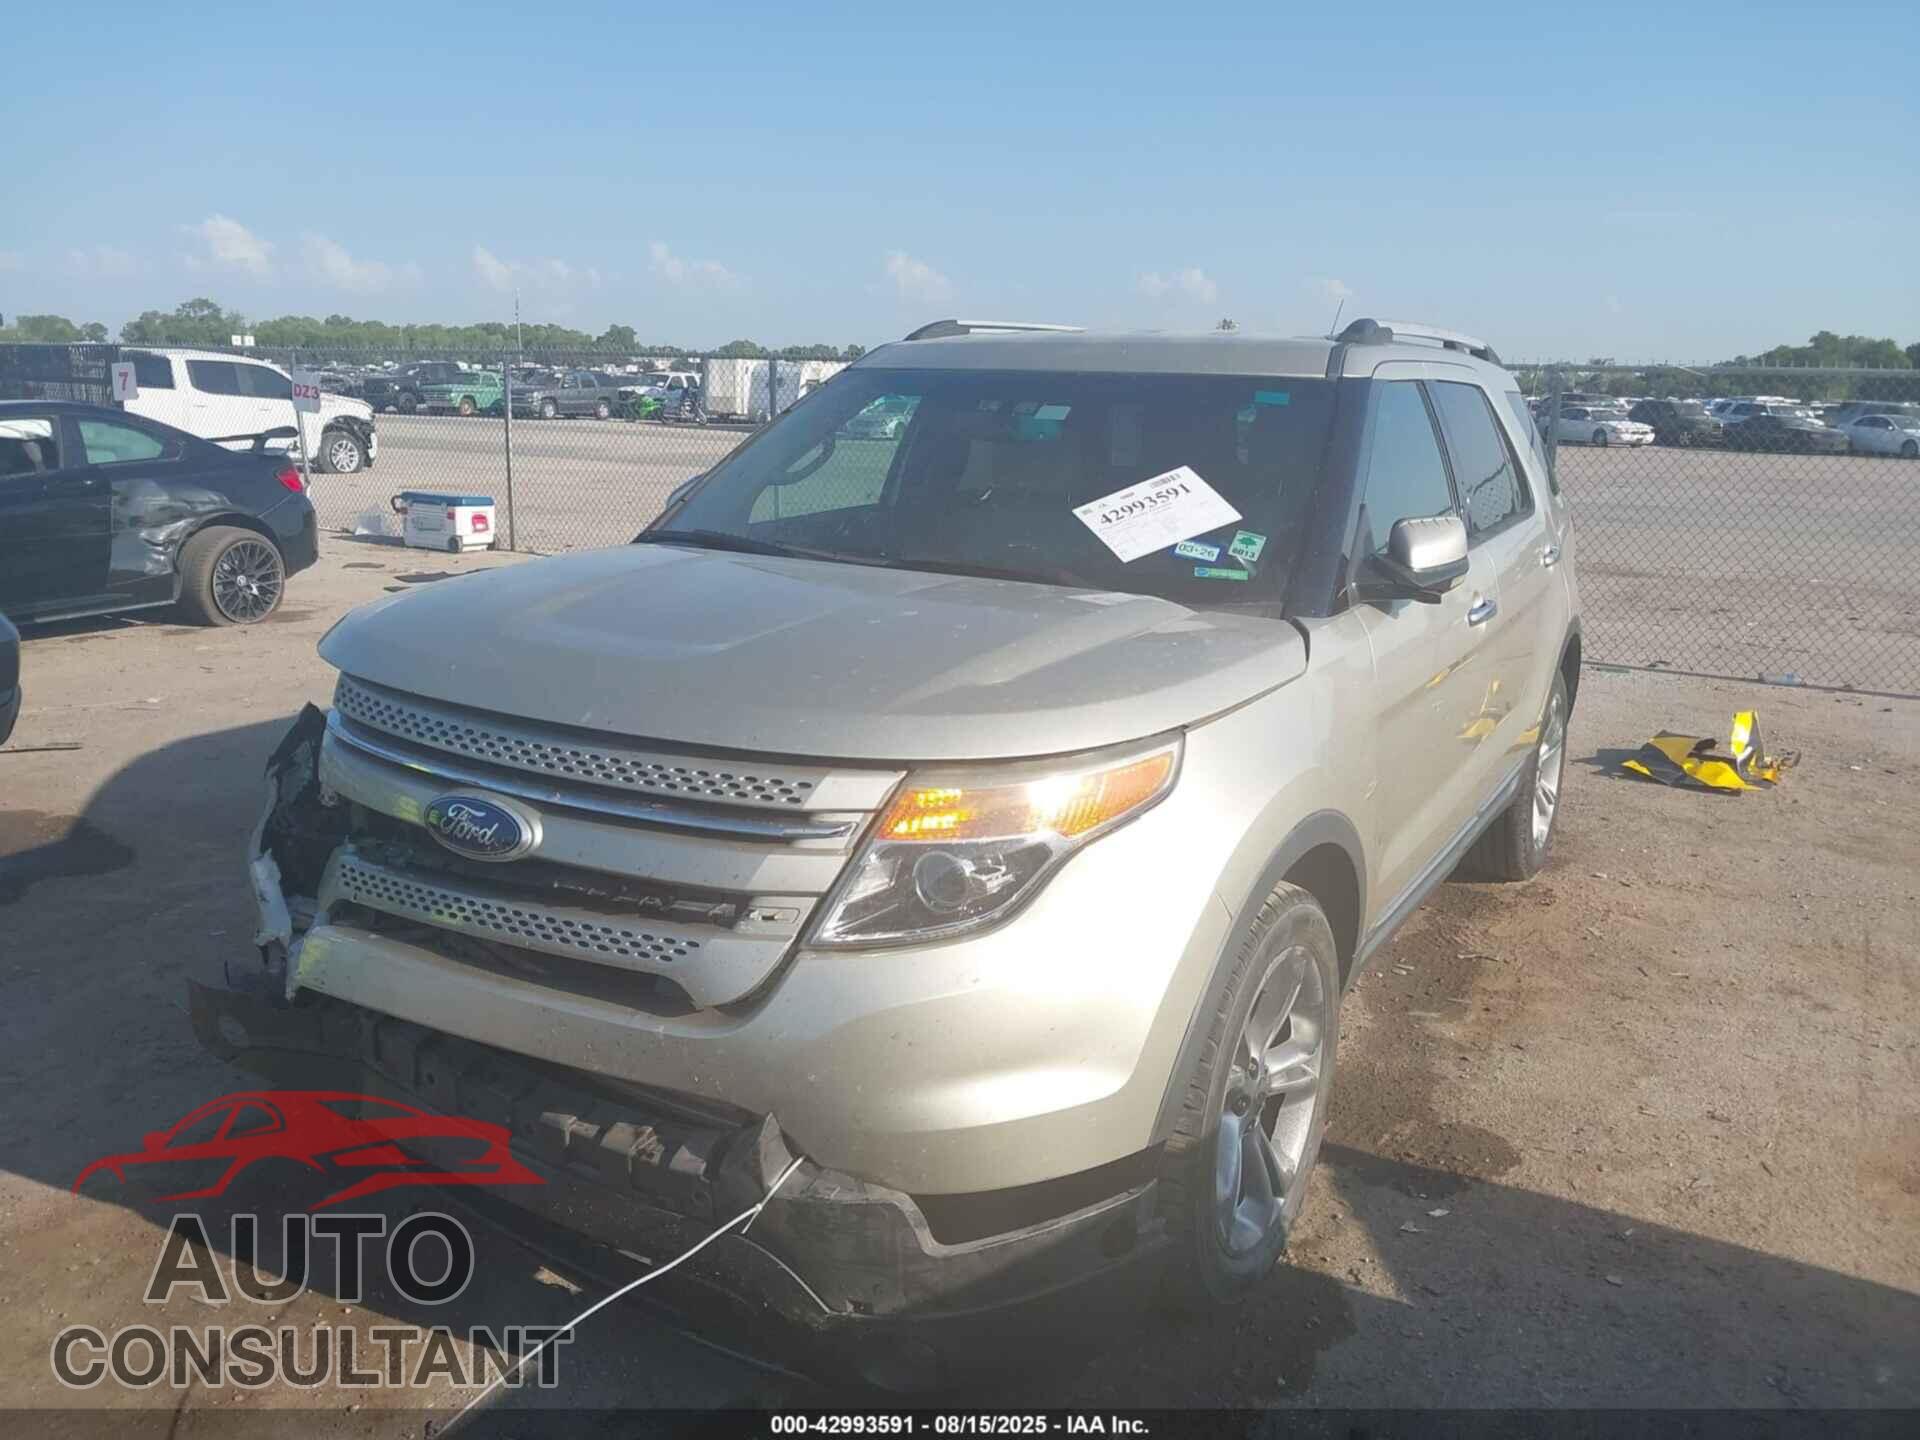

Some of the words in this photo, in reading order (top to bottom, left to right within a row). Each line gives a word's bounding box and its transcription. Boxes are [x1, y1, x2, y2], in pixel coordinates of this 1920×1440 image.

[118, 371, 129, 391] 7
[1100, 483, 1191, 525] 42993591
[440, 803, 500, 847] Ford
